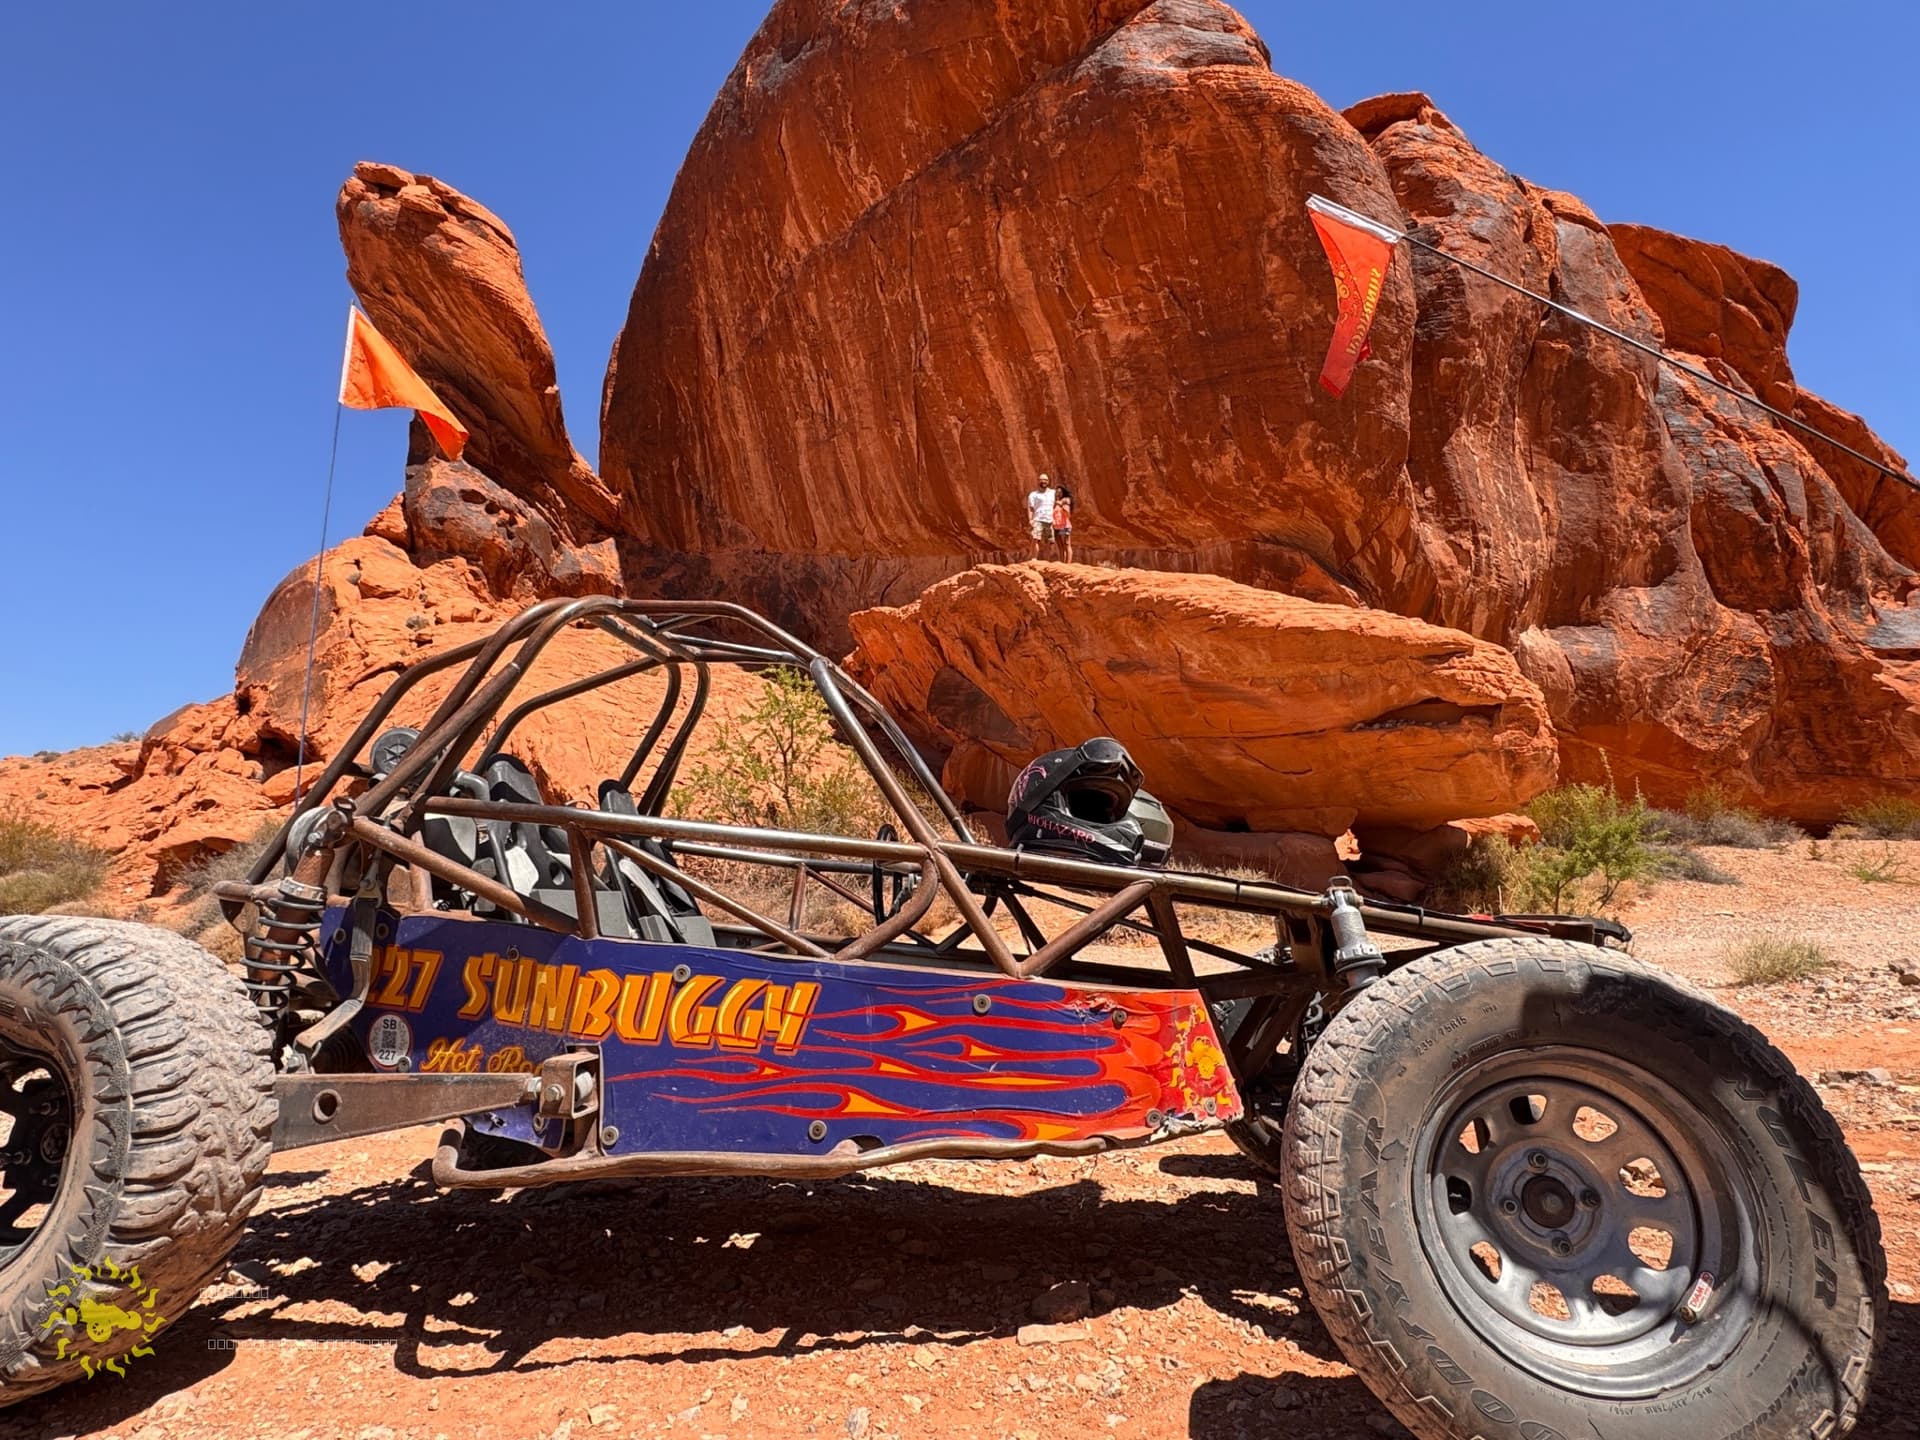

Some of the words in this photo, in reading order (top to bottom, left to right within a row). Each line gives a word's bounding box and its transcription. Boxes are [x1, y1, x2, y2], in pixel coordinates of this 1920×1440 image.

[1027, 814, 1096, 848] BIOHAZARD
[457, 952, 823, 1055] SUNBUGGY
[382, 1018, 397, 1030] SB
[379, 1049, 396, 1061] 227
[419, 1037, 484, 1073] Hot
[486, 1045, 544, 1076] Ro
